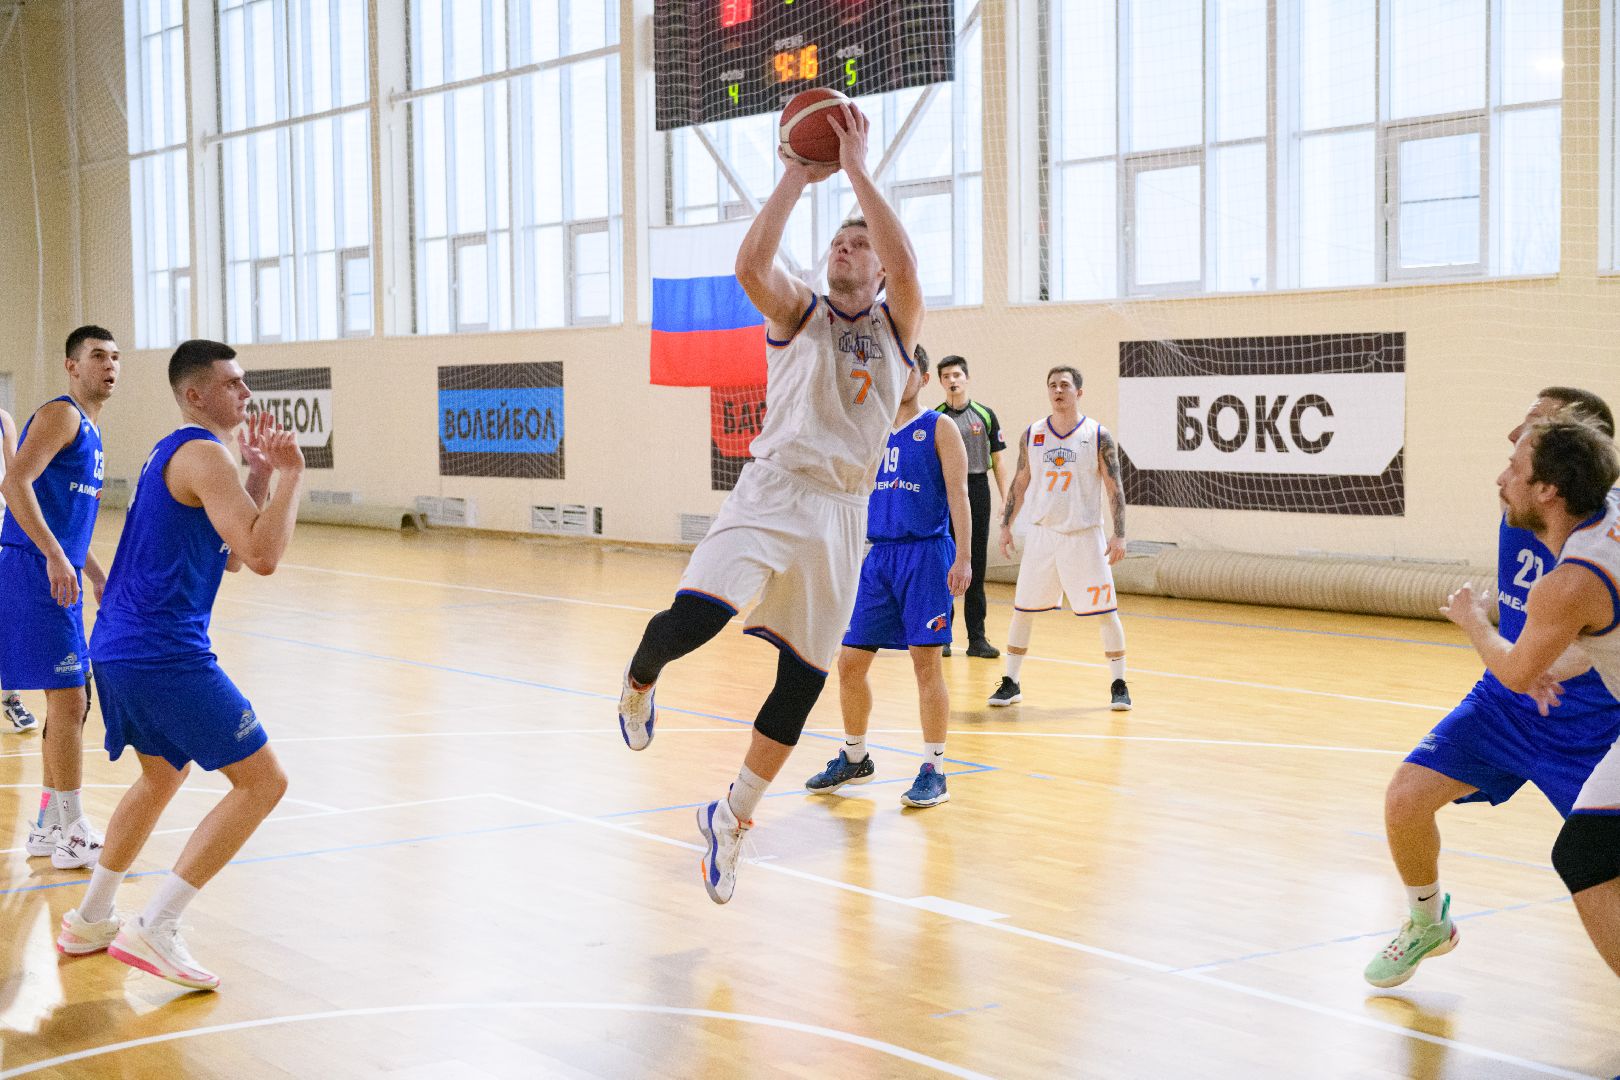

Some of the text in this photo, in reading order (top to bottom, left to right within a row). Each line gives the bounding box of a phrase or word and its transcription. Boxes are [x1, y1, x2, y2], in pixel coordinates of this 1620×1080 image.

[774, 44, 818, 82] 9:16
[845, 58, 857, 86] 5
[728, 82, 739, 105] 4
[850, 369, 872, 405] 7
[444, 400, 556, 441] ВОЛЕЙБОЛ
[1176, 393, 1335, 454] БОКС
[883, 446, 900, 473] 19
[1045, 470, 1073, 492] 77
[1087, 583, 1111, 606] 77
